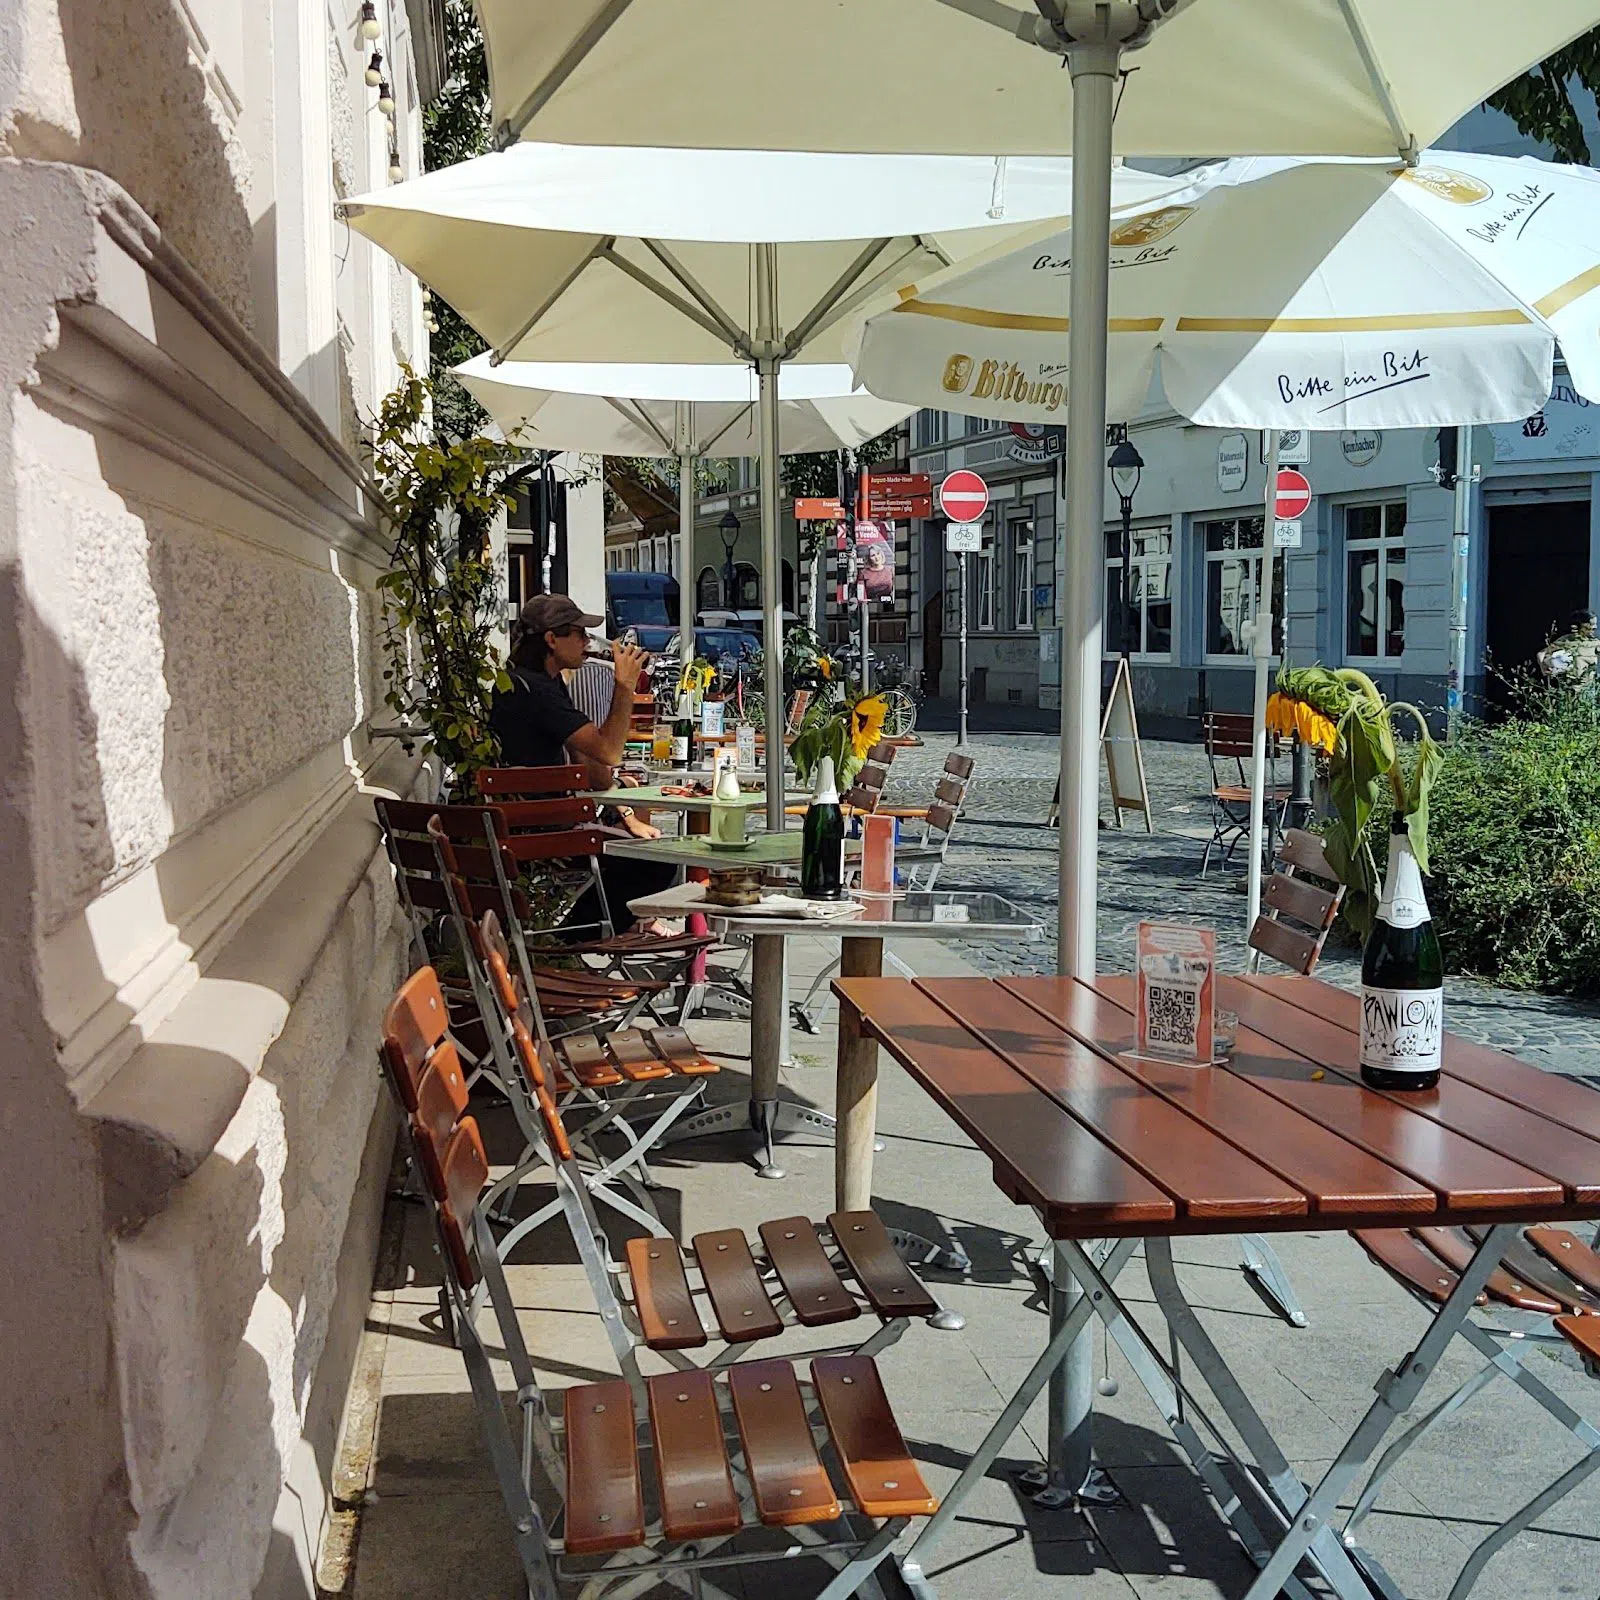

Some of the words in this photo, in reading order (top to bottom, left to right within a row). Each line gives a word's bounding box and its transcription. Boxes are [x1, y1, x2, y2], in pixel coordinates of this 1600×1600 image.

[1507, 184, 1541, 205] Bit
[1503, 208, 1525, 221] ein
[1466, 221, 1506, 243] Bitte
[1032, 255, 1071, 270] Bitt
[1135, 245, 1179, 261] Bit
[1278, 374, 1333, 404] Bitte
[1344, 371, 1376, 387] ein
[1383, 349, 1429, 377] Bit
[959, 541, 971, 549] frei
[1363, 994, 1440, 1035] PAWLOW
